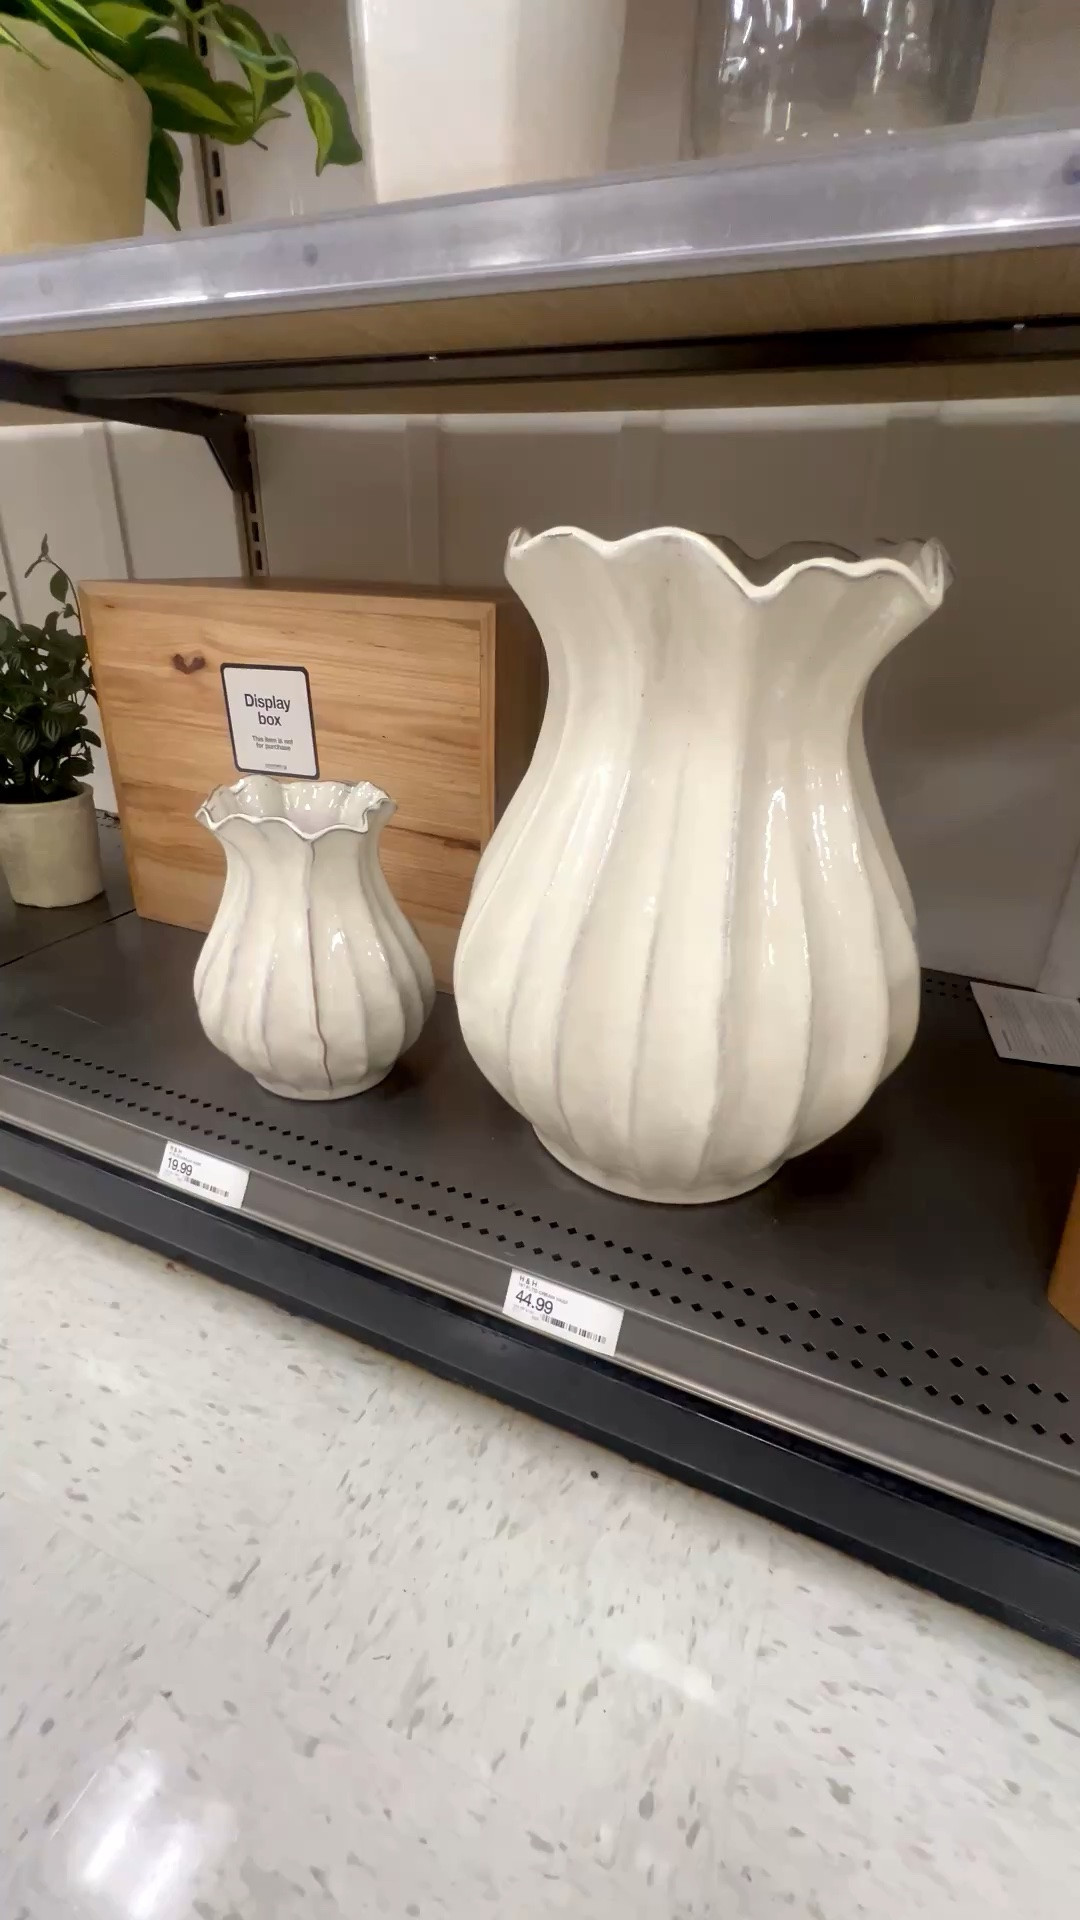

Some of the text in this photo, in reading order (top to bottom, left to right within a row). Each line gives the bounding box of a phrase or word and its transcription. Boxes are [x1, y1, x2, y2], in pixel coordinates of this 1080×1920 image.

[244, 693, 291, 712] Display
[258, 711, 282, 726] box
[265, 743, 291, 751] purchase
[168, 1157, 193, 1176] 19.99
[515, 1290, 554, 1315] 44.99
